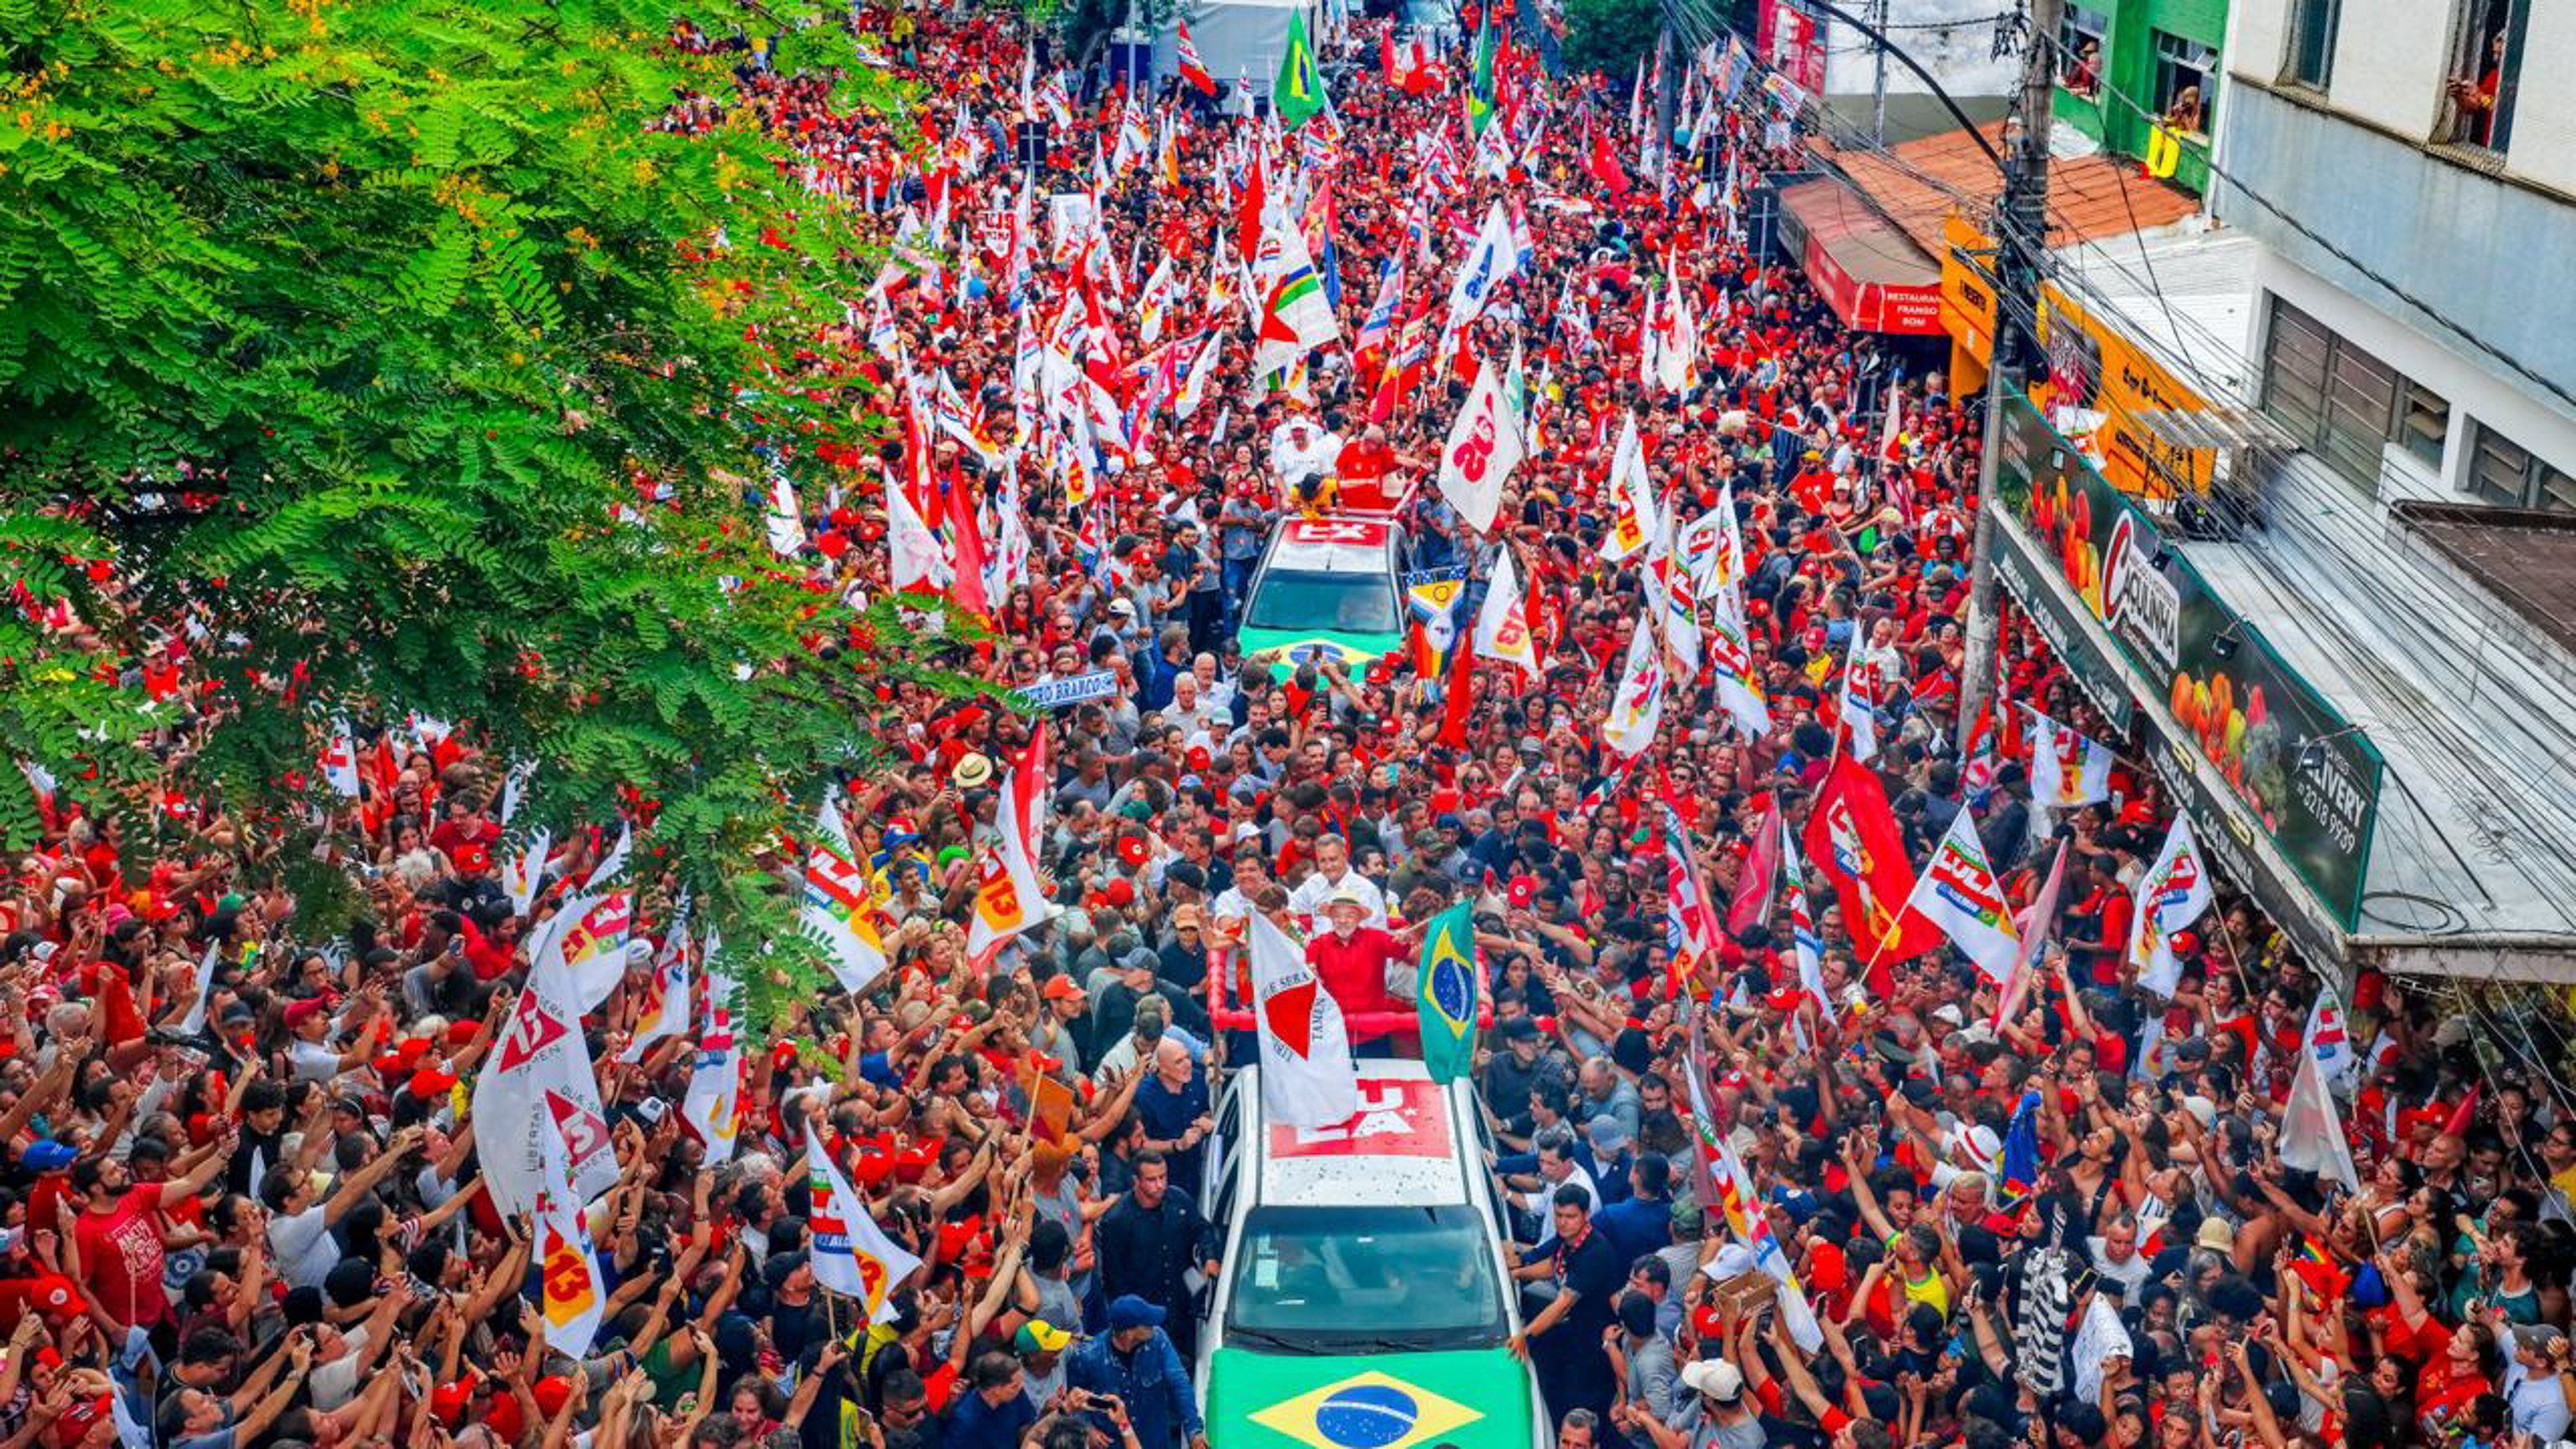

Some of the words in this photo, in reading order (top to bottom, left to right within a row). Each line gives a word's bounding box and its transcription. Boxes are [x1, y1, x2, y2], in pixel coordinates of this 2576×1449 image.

[2303, 784, 2329, 827] 3218
[2328, 813, 2355, 854] 9939
[543, 1249, 593, 1303] 13
